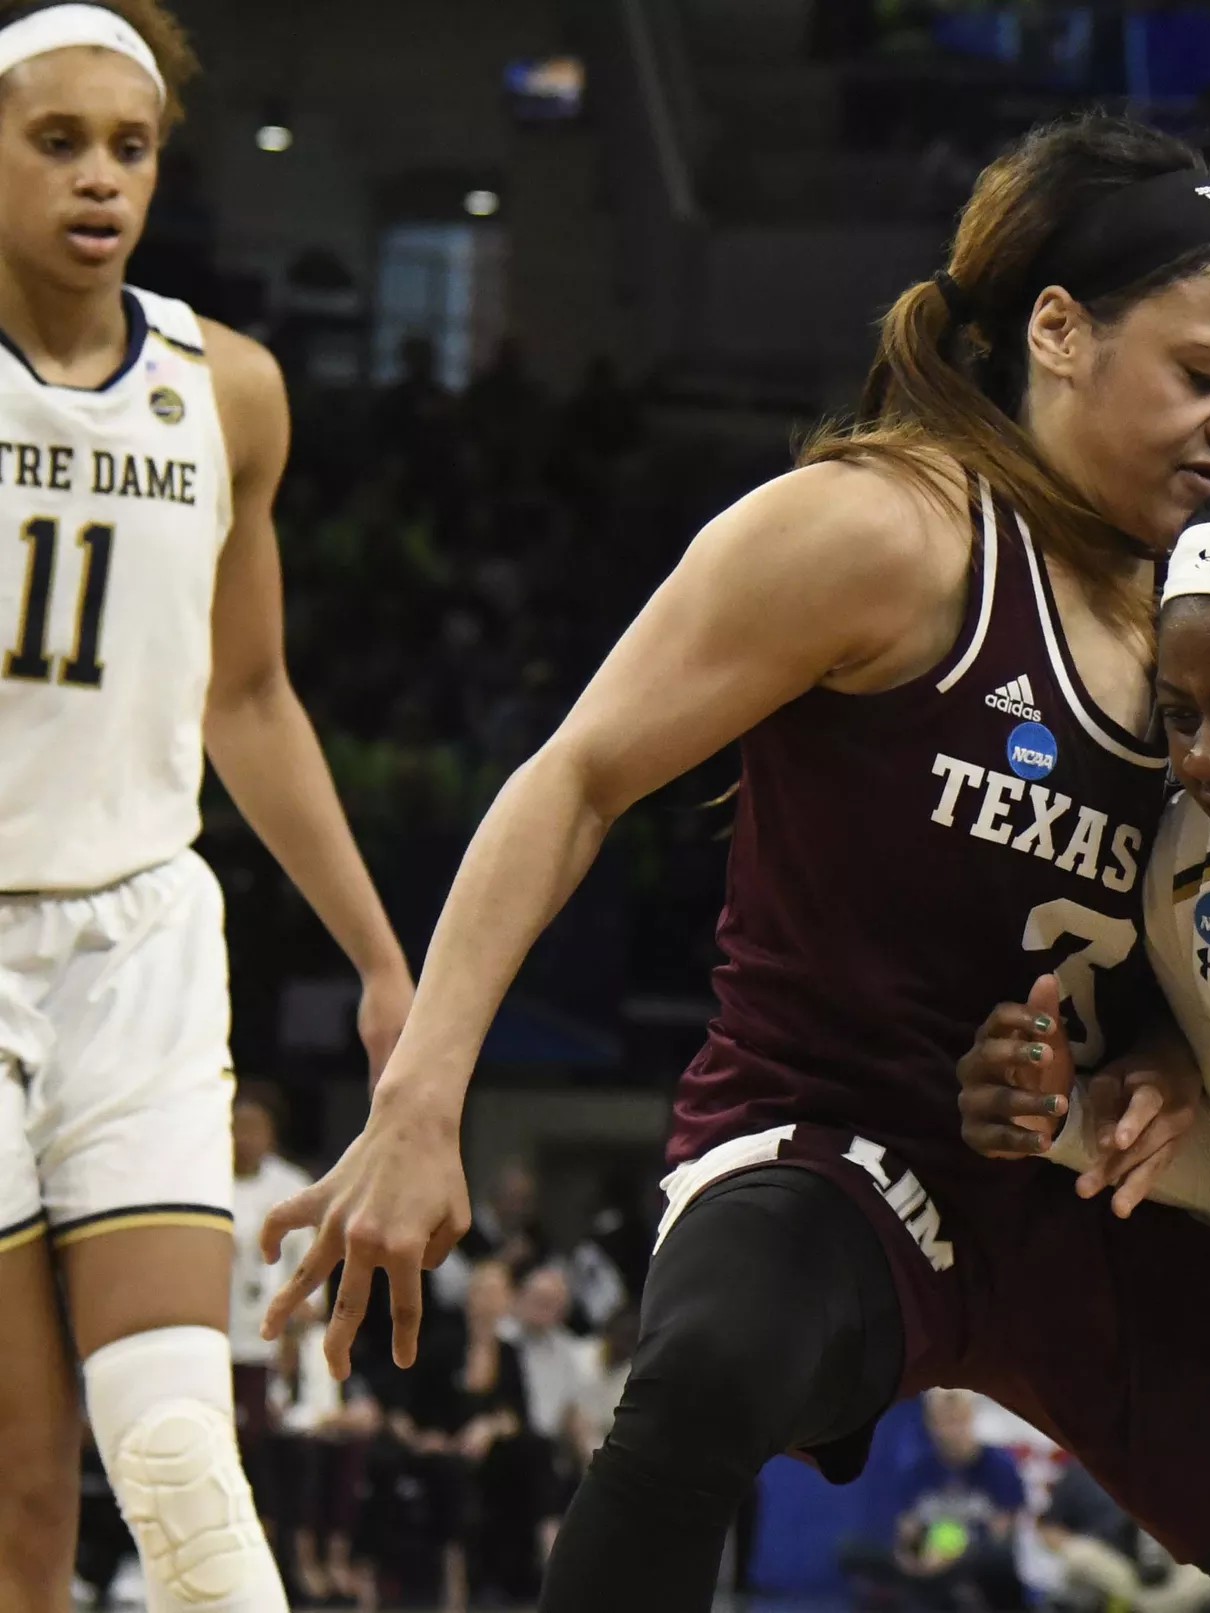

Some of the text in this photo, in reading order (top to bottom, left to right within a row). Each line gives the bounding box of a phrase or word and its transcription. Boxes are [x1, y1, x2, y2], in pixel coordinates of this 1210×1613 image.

[92, 449, 196, 506] DAME
[3, 514, 117, 689] 11
[985, 694, 1042, 722] adidas
[1012, 746, 1053, 770] NCAA
[931, 753, 1142, 893] TEXAS
